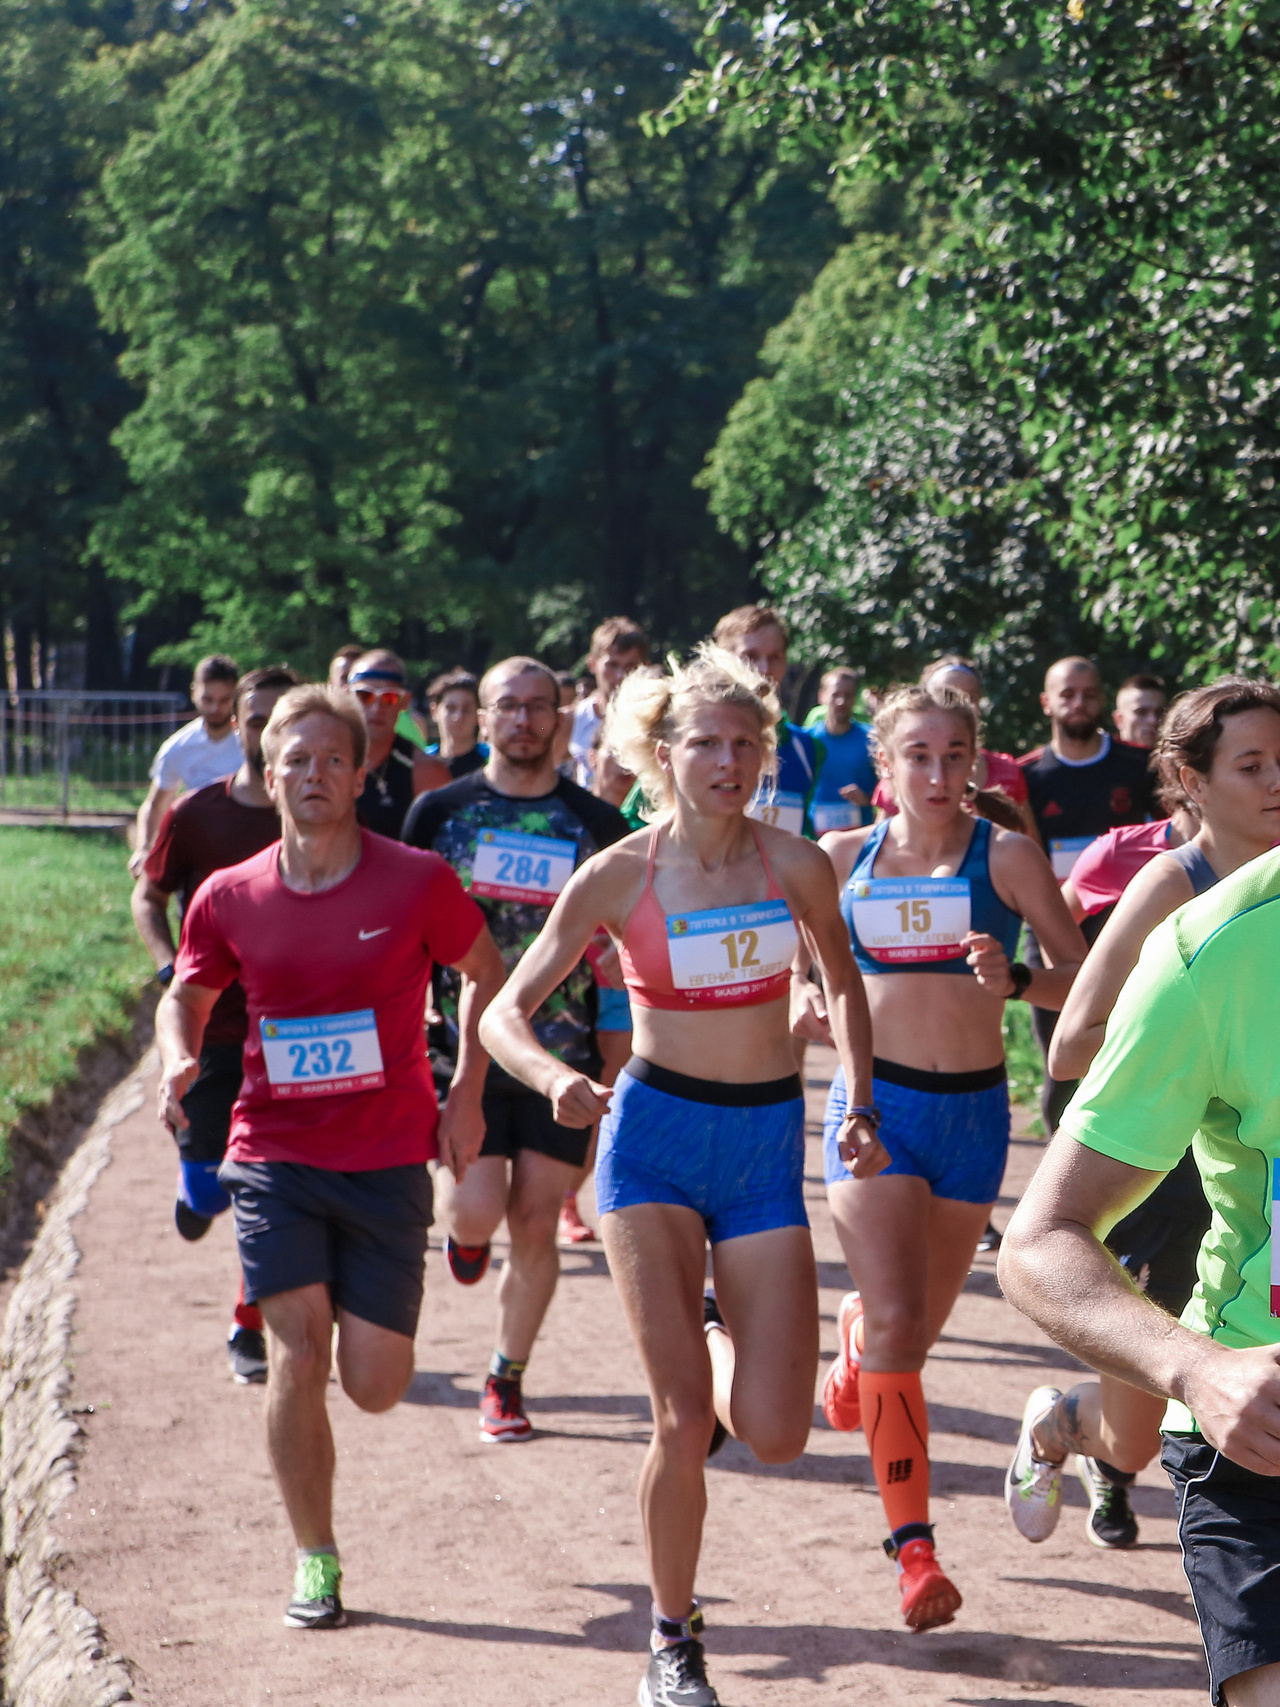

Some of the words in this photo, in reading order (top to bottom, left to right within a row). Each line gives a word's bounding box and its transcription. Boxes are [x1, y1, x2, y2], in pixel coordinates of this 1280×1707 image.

[495, 852, 551, 888] 284
[896, 900, 931, 933] 15
[721, 930, 760, 969] 12
[288, 1038, 355, 1079] 232
